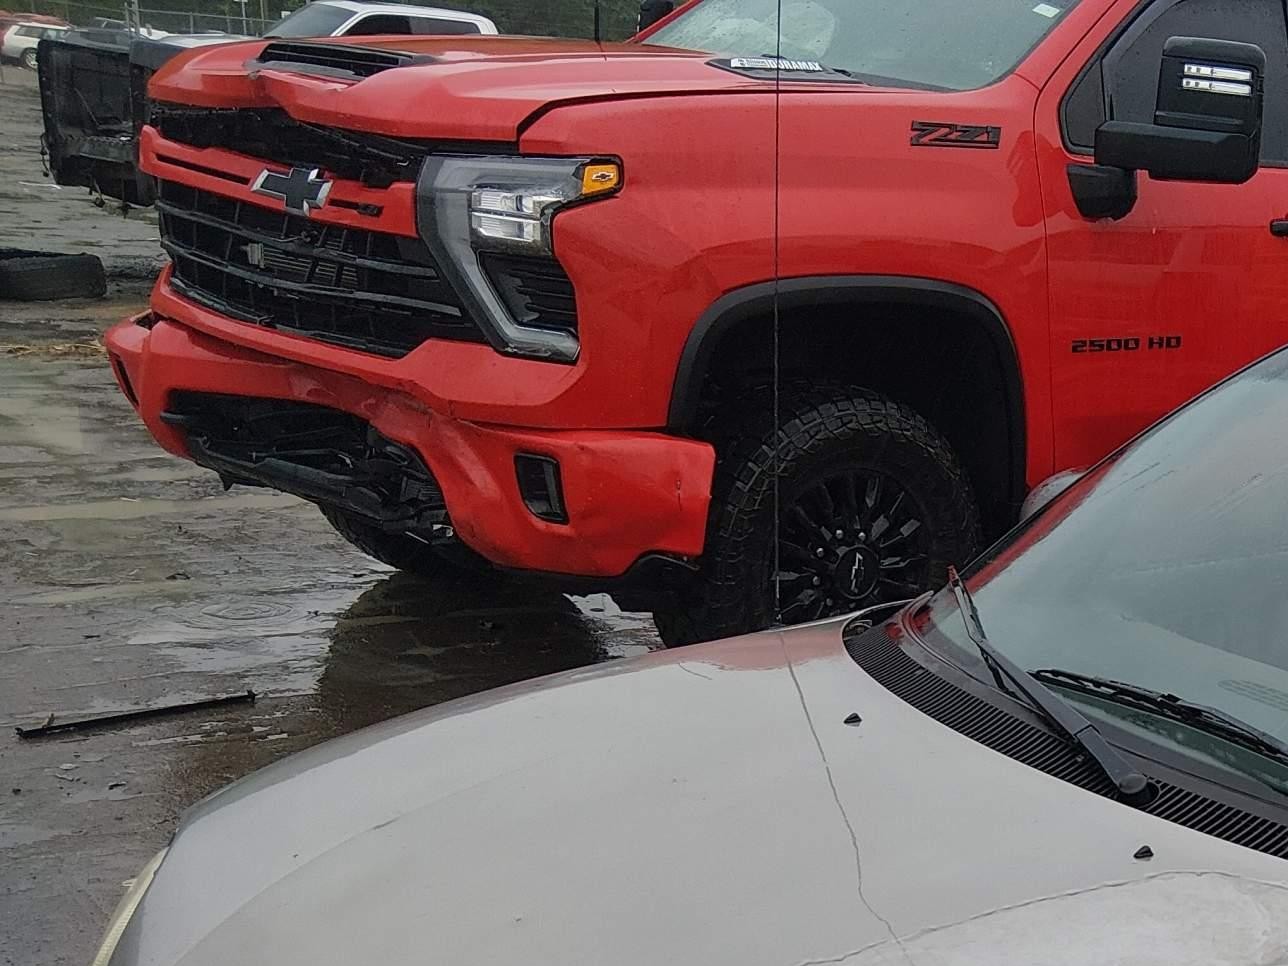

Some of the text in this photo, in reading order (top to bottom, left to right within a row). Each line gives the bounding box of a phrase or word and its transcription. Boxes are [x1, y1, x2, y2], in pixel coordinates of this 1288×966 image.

[766, 59, 822, 72] DURAMAX
[910, 120, 1001, 149] Z71
[1072, 336, 1181, 353] 2500 HD
